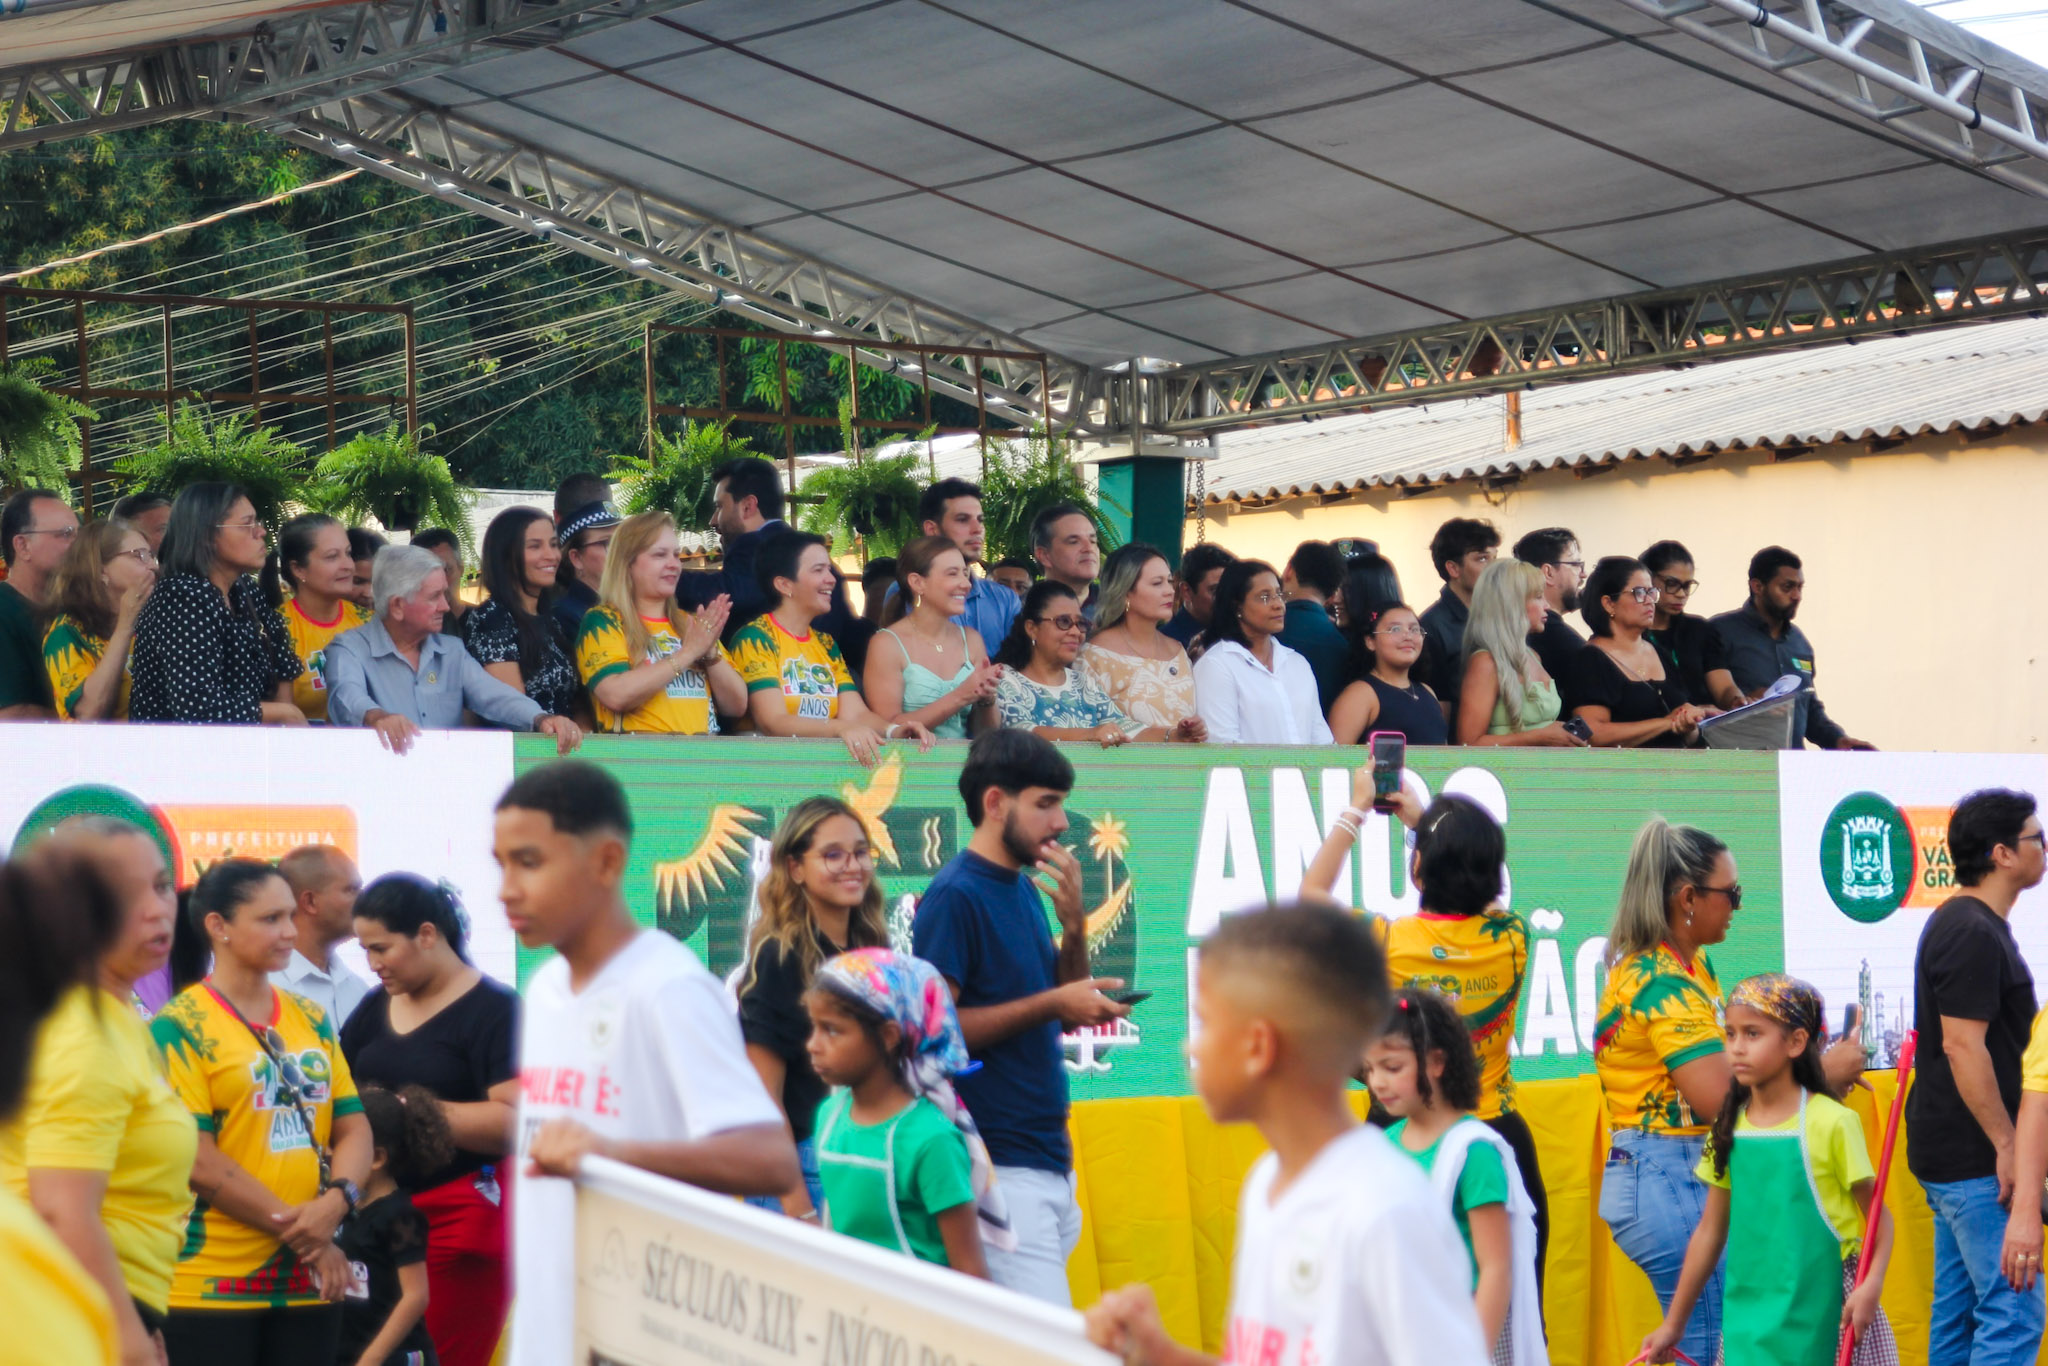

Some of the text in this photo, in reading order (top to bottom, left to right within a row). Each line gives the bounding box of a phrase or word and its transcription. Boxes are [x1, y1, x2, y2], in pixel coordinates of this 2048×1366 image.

[800, 697, 829, 717] ANOS
[190, 831, 336, 847] PREFEITURA
[1465, 975, 1498, 993] ANOS
[642, 1233, 750, 1336] SÉCULOS
[752, 1282, 803, 1356] XIX
